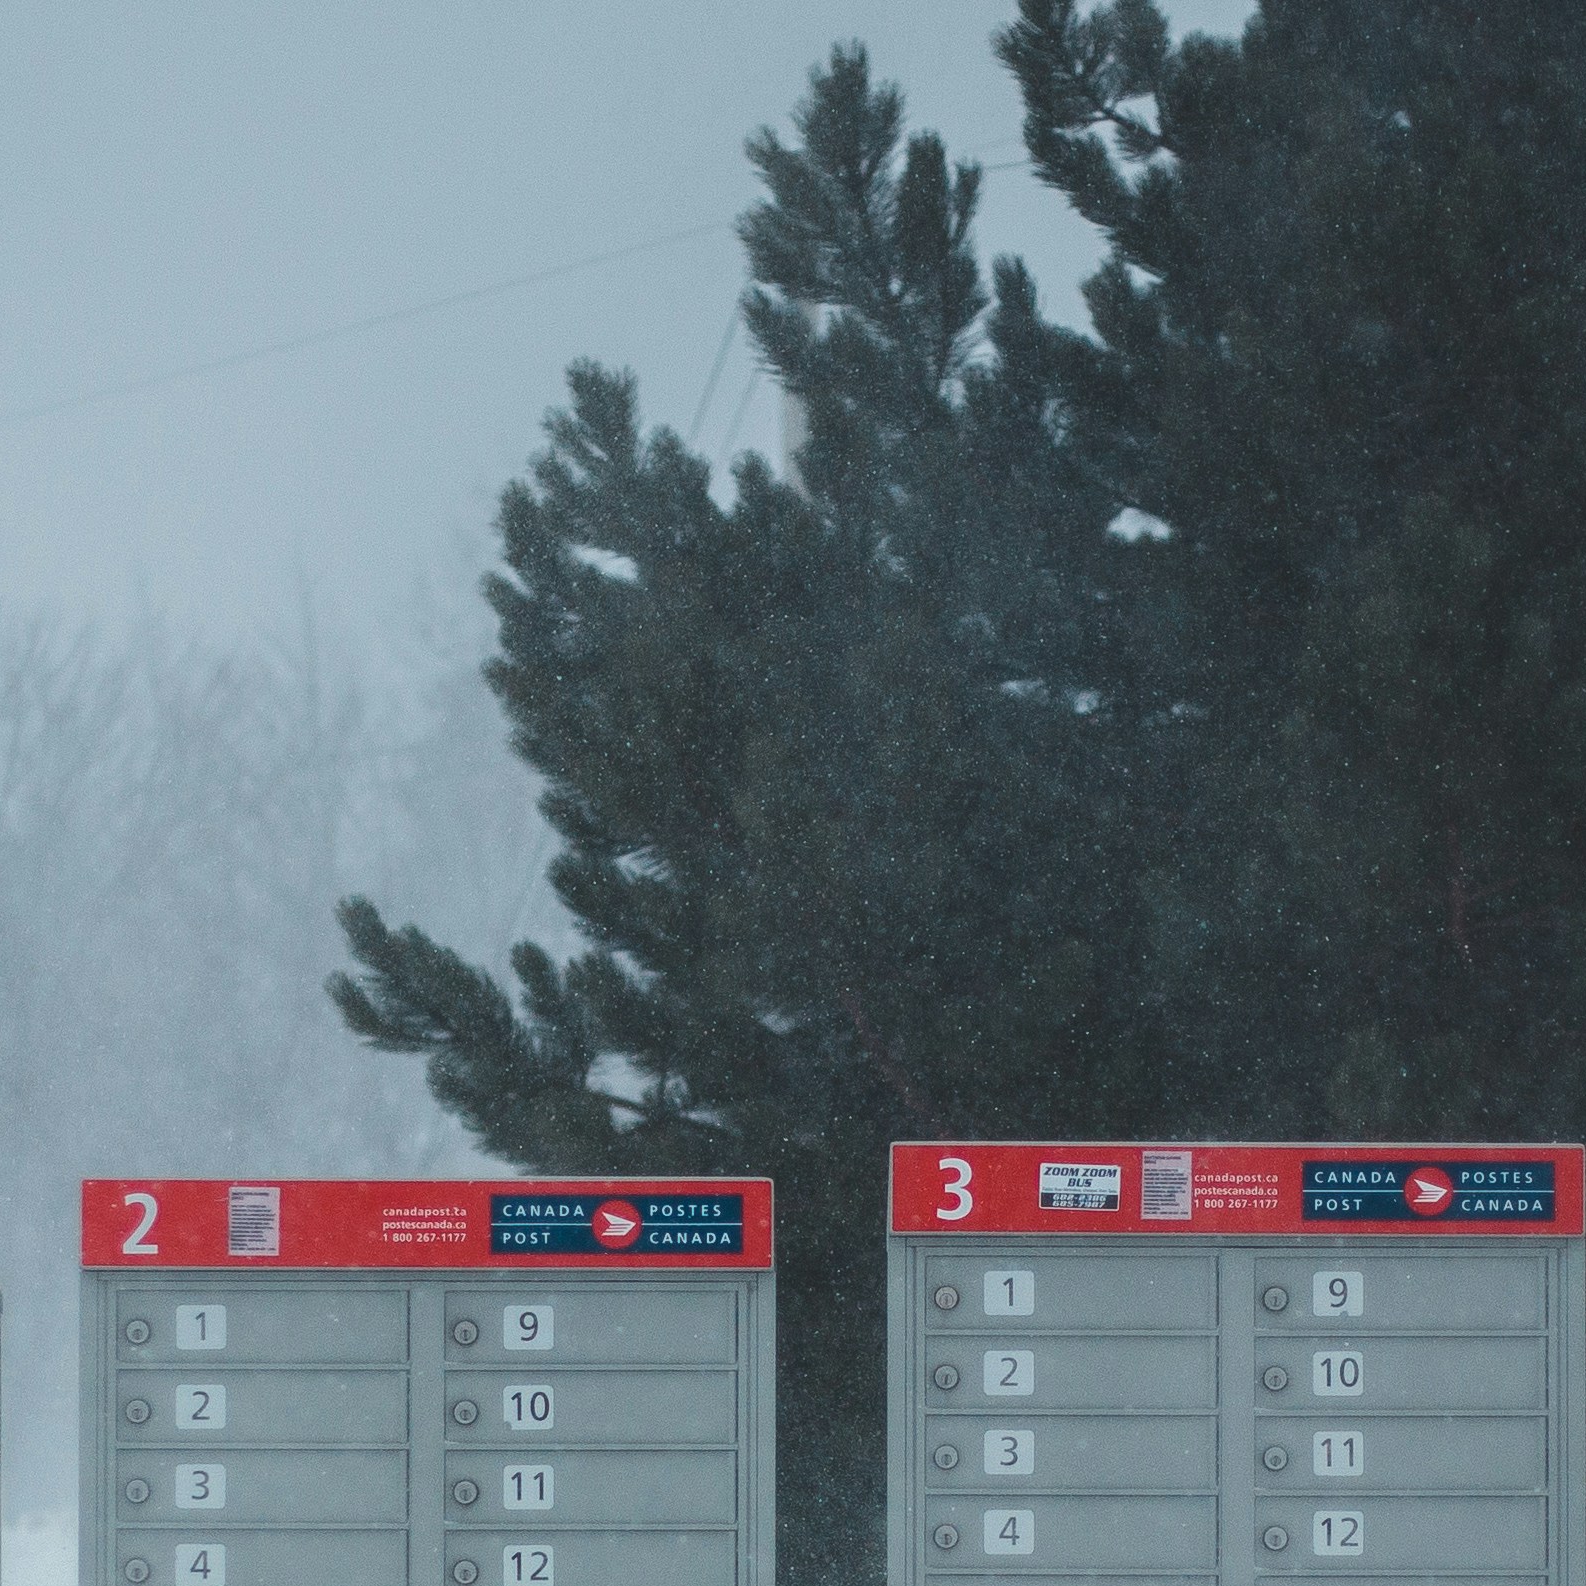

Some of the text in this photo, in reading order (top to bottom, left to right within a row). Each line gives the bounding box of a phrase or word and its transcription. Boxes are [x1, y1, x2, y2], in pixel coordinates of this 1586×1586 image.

[1043, 1167, 1118, 1178] ZOOM ZOOM
[1067, 1178, 1093, 1187] BUS
[1194, 1173, 1278, 1184] canadapost.ca
[1314, 1171, 1396, 1184] CANADA
[1461, 1171, 1533, 1184] POSTES
[936, 1157, 973, 1220] 3
[1194, 1186, 1278, 1197] postescanada.ca
[1194, 1199, 1278, 1208] 1 800 267-1177
[383, 1207, 467, 1218] canadapost.ca
[503, 1205, 585, 1217] CANADA
[649, 1205, 722, 1217] POSTES
[1314, 1199, 1363, 1211] POST
[1461, 1199, 1543, 1212] CANADA
[123, 1192, 158, 1255] 2
[383, 1220, 467, 1231] postescanada.ca
[383, 1233, 467, 1242] 1 800 267-1177
[503, 1232, 551, 1244] POST
[649, 1232, 731, 1244] CANADA
[1002, 1277, 1014, 1307] 1
[1328, 1277, 1348, 1308] 9
[194, 1311, 206, 1341] 1
[519, 1311, 539, 1342] 9
[999, 1356, 1019, 1387] 2
[1320, 1357, 1360, 1388] 10
[191, 1390, 210, 1421] 2
[510, 1391, 550, 1422] 10
[999, 1436, 1019, 1467] 3
[1320, 1437, 1354, 1468] 11
[191, 1470, 210, 1501] 3
[511, 1471, 544, 1501] 11
[998, 1516, 1021, 1546] 4
[1321, 1517, 1359, 1547] 12
[189, 1550, 212, 1580] 4
[511, 1551, 549, 1581] 12
